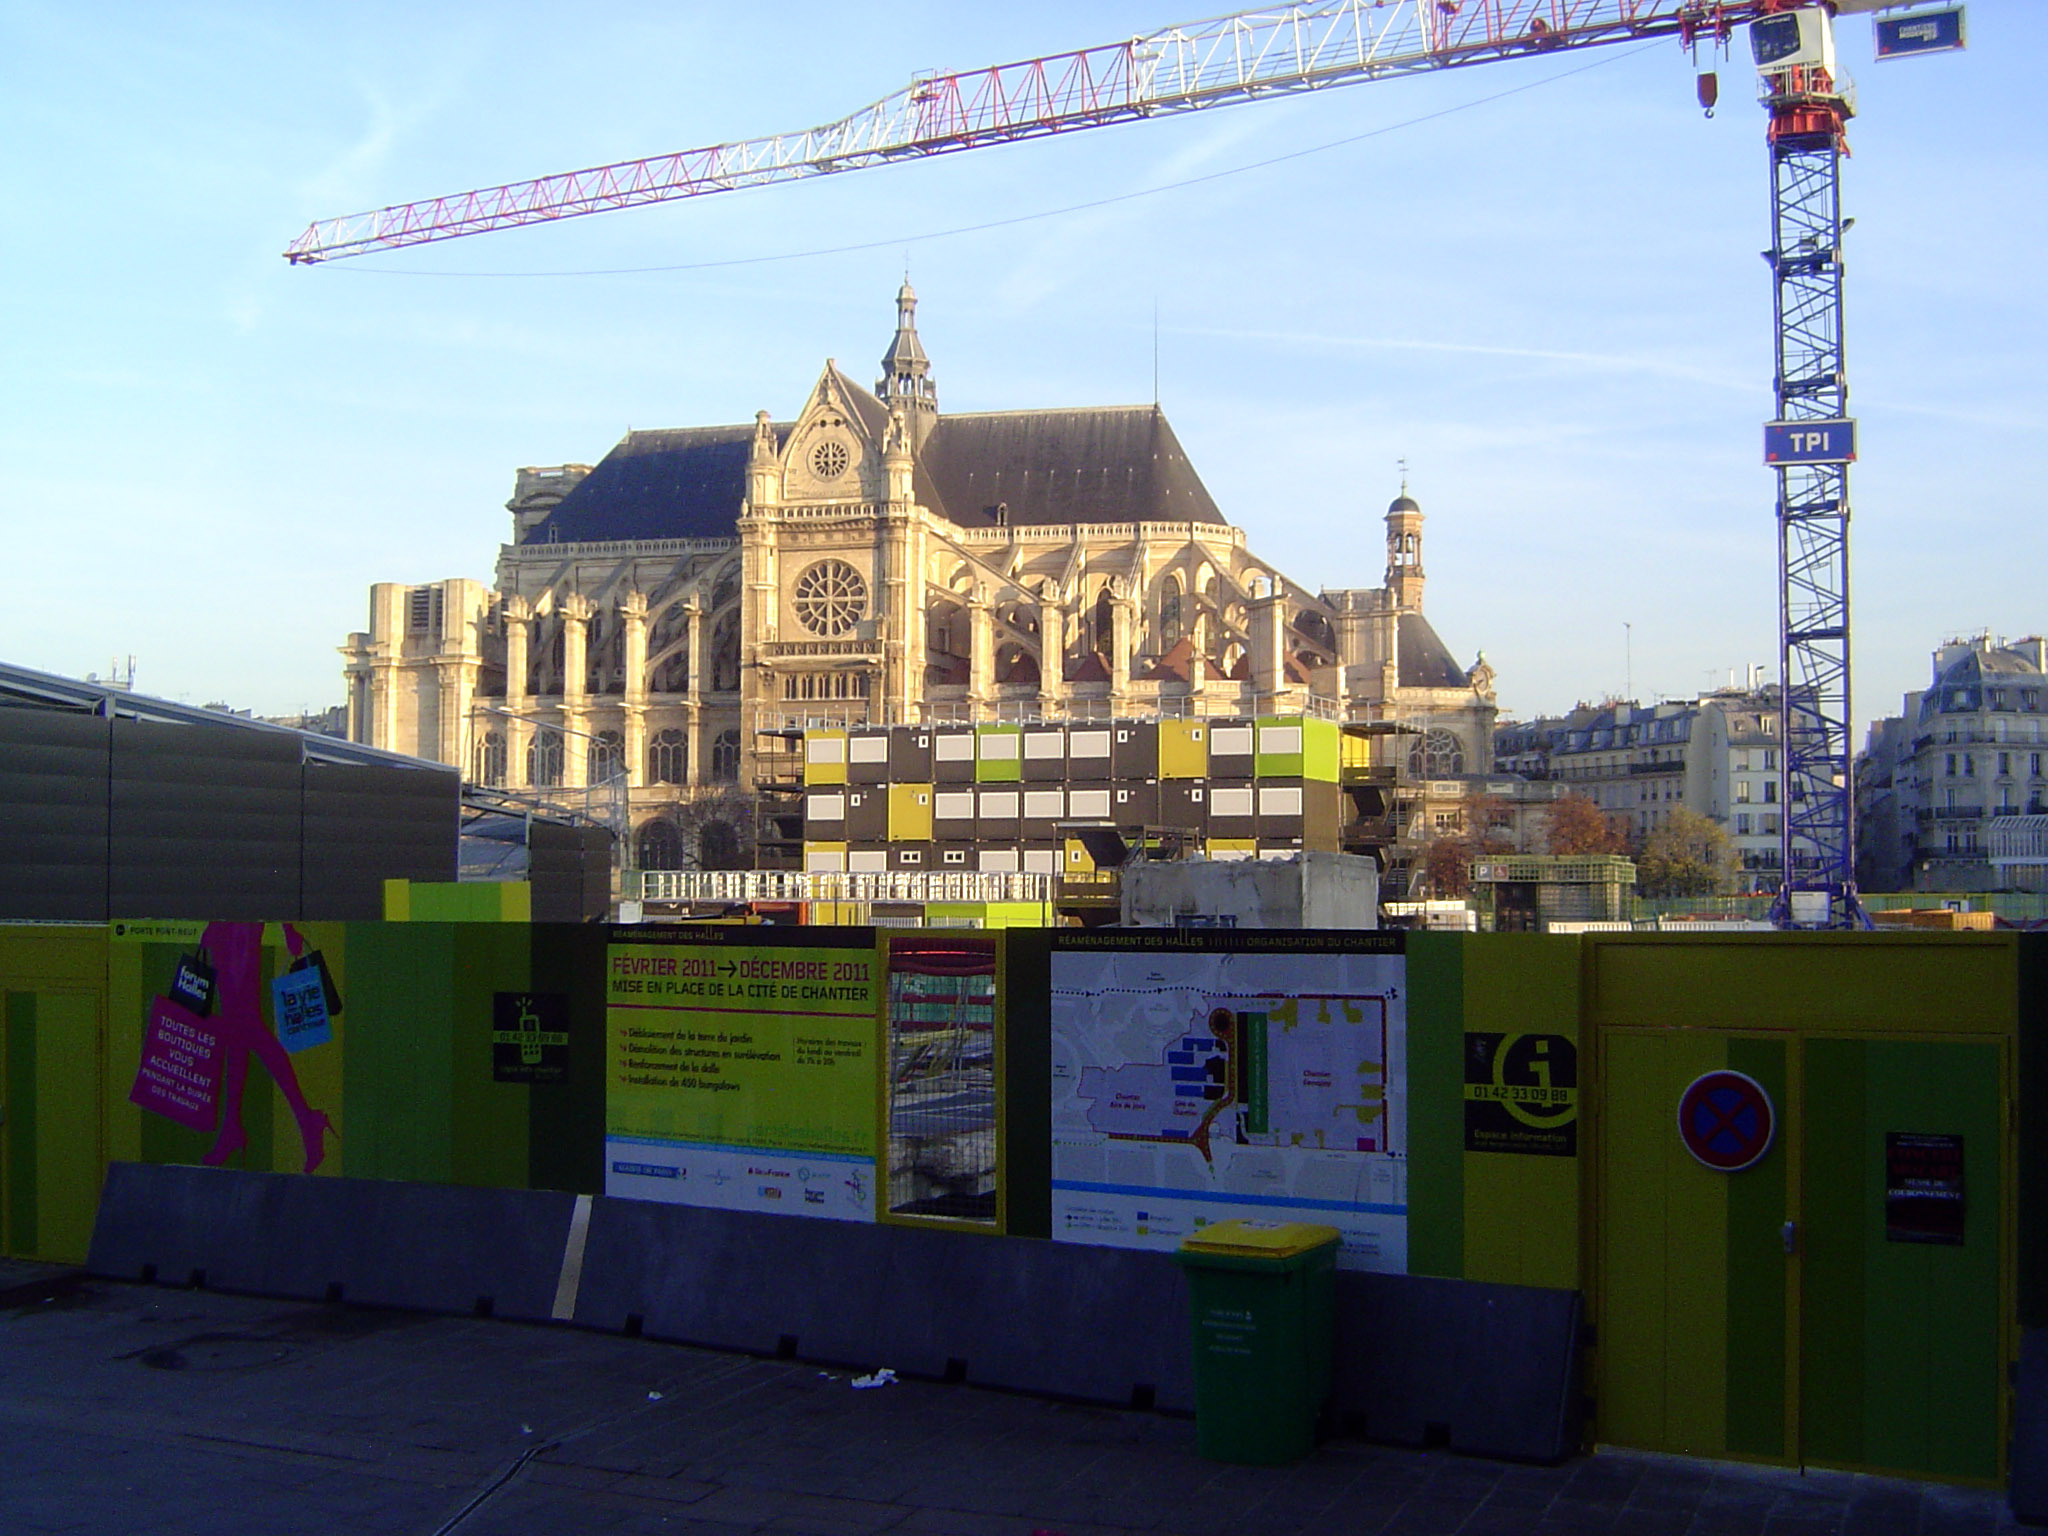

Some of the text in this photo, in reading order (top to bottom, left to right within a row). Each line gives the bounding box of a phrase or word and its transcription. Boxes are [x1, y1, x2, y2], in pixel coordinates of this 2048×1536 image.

[1789, 431, 1829, 453] TPI
[1058, 934, 1143, 946] RÉAMÉNAGEMENT
[1144, 936, 1163, 946] DES
[1247, 936, 1324, 947] ORGANISATION
[1327, 937, 1341, 947] DU
[1344, 937, 1397, 947] CHANTIER
[180, 965, 209, 989] forum
[613, 953, 869, 982] FÉVRIER 2011 DÉCEMBRE 2011
[178, 979, 207, 1000] Halles
[281, 984, 320, 1007] la vie
[612, 980, 869, 1001] MISE EN PLACE DE LA CITÉ DE CHANTIER
[160, 1015, 216, 1046] TOUTES LES
[677, 1029, 686, 1040] de
[688, 1030, 695, 1041] la
[158, 1029, 211, 1059] BOUTIQUES
[669, 1045, 682, 1056] des
[169, 1048, 194, 1067] VOUS
[680, 1060, 690, 1072] de
[691, 1061, 699, 1073] la
[142, 1067, 176, 1087] PENDANT
[177, 1082, 186, 1092] LA
[150, 1055, 211, 1087] ACCUEILLENT
[669, 1076, 679, 1087] de
[168, 1091, 199, 1111] TRAVAUX
[1474, 1086, 1567, 1101] 01 42 33 09 88
[1473, 1128, 1508, 1141] Espace
